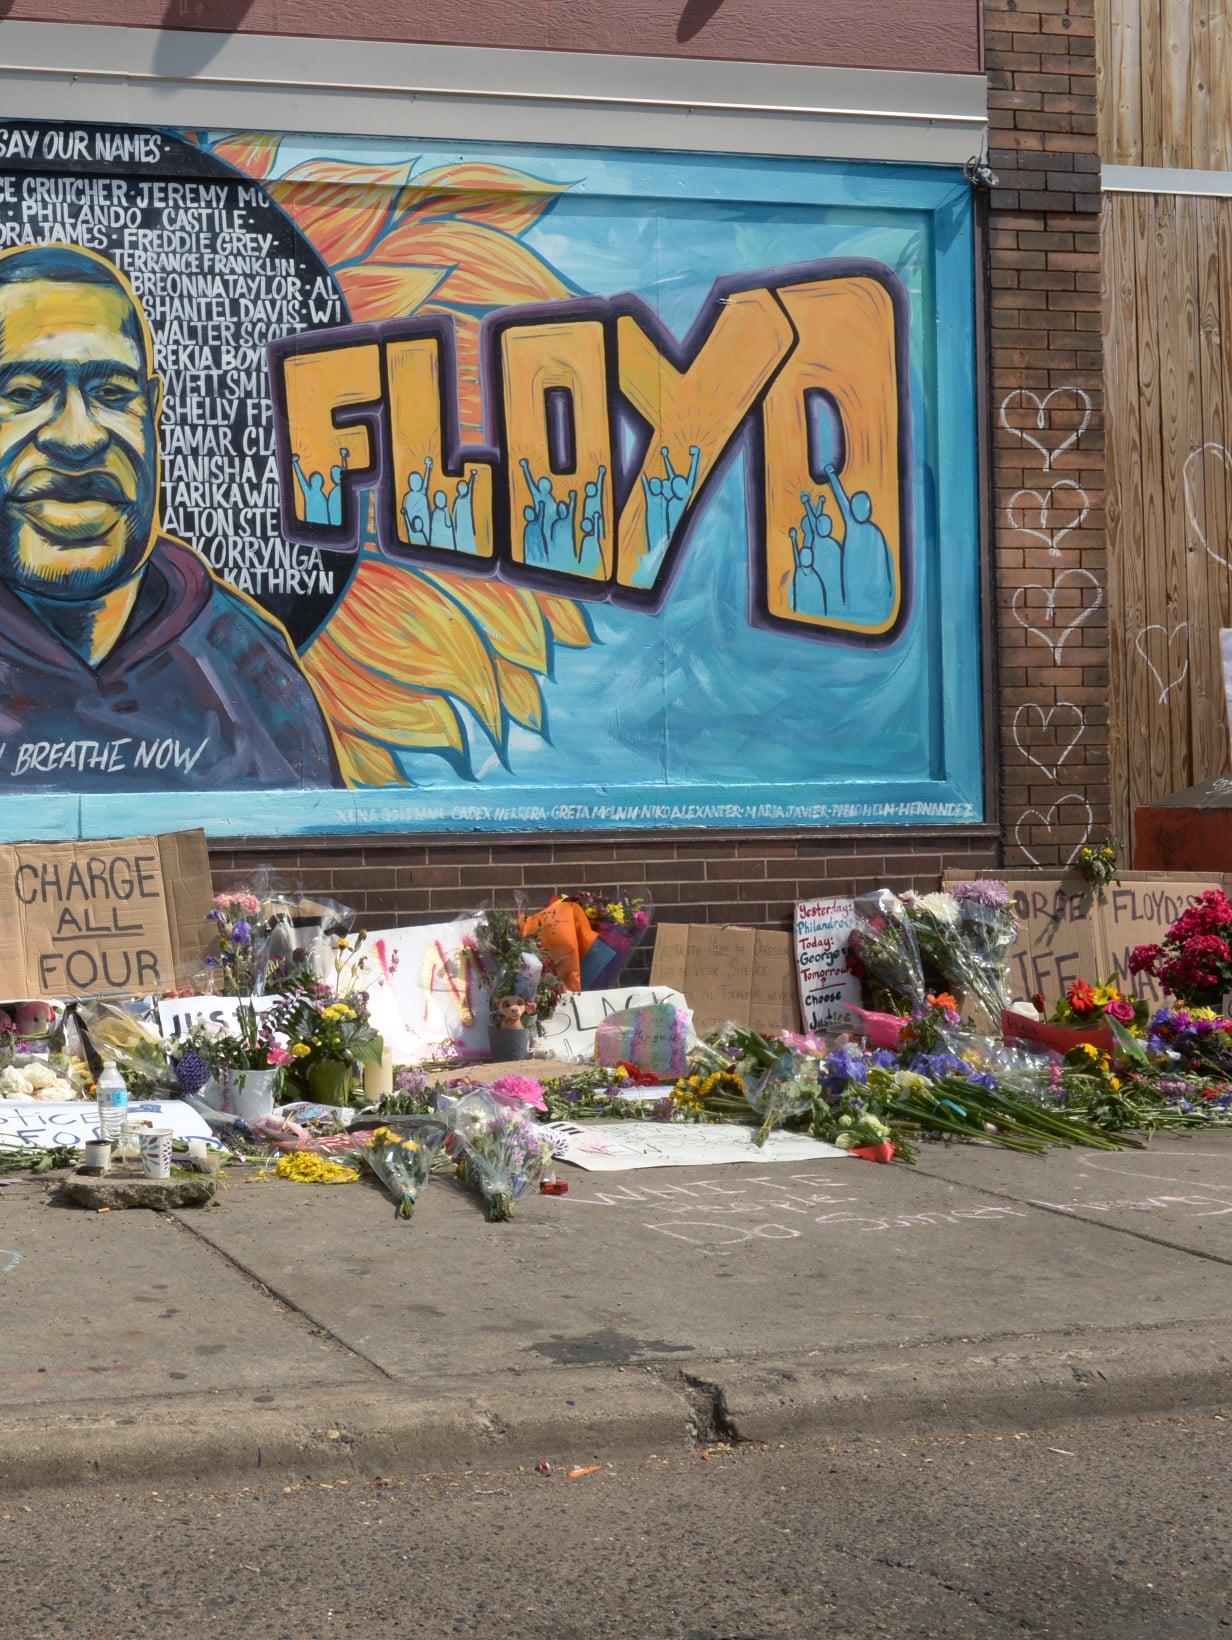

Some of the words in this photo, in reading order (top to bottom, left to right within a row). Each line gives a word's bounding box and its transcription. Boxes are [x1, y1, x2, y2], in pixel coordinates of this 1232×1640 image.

[42, 130, 94, 161] OUR
[96, 132, 161, 163] NAMES
[22, 177, 127, 206] CRUTCHER
[136, 182, 229, 209] JEREMY
[22, 202, 142, 228] PHILANDO
[162, 208, 248, 233] CASTILE
[35, 222, 109, 249] JAMES
[124, 229, 212, 254] FREDDIE
[217, 233, 273, 258] GREY
[112, 249, 201, 274] TERRANCE
[203, 254, 296, 276] FRANKLIN
[131, 271, 223, 298] BREONNA
[223, 274, 303, 301] TAYLOR
[141, 295, 239, 323] SHANTEL
[239, 298, 301, 324] DAVIS
[148, 321, 235, 347] WALTER
[153, 344, 217, 371] REKIA
[157, 370, 223, 397] YVETT
[161, 395, 238, 426] SHELLY
[157, 425, 237, 457] JAMAR
[271, 262, 909, 647] FLOYD
[161, 455, 258, 484] TANISHA
[161, 482, 244, 509] TARIKA
[162, 506, 235, 538] ALTON
[224, 567, 335, 596] KATHRYN
[10, 737, 133, 777] BREATHE
[134, 736, 210, 775] NOW
[551, 803, 591, 821] GRETA
[14, 855, 161, 905] CHARGE
[56, 906, 144, 935] ALL
[1012, 889, 1088, 923] ORGE
[799, 936, 835, 951] Today:
[39, 949, 161, 990] FOUR
[801, 966, 850, 983] Tomorrow
[805, 990, 842, 1006] Choose
